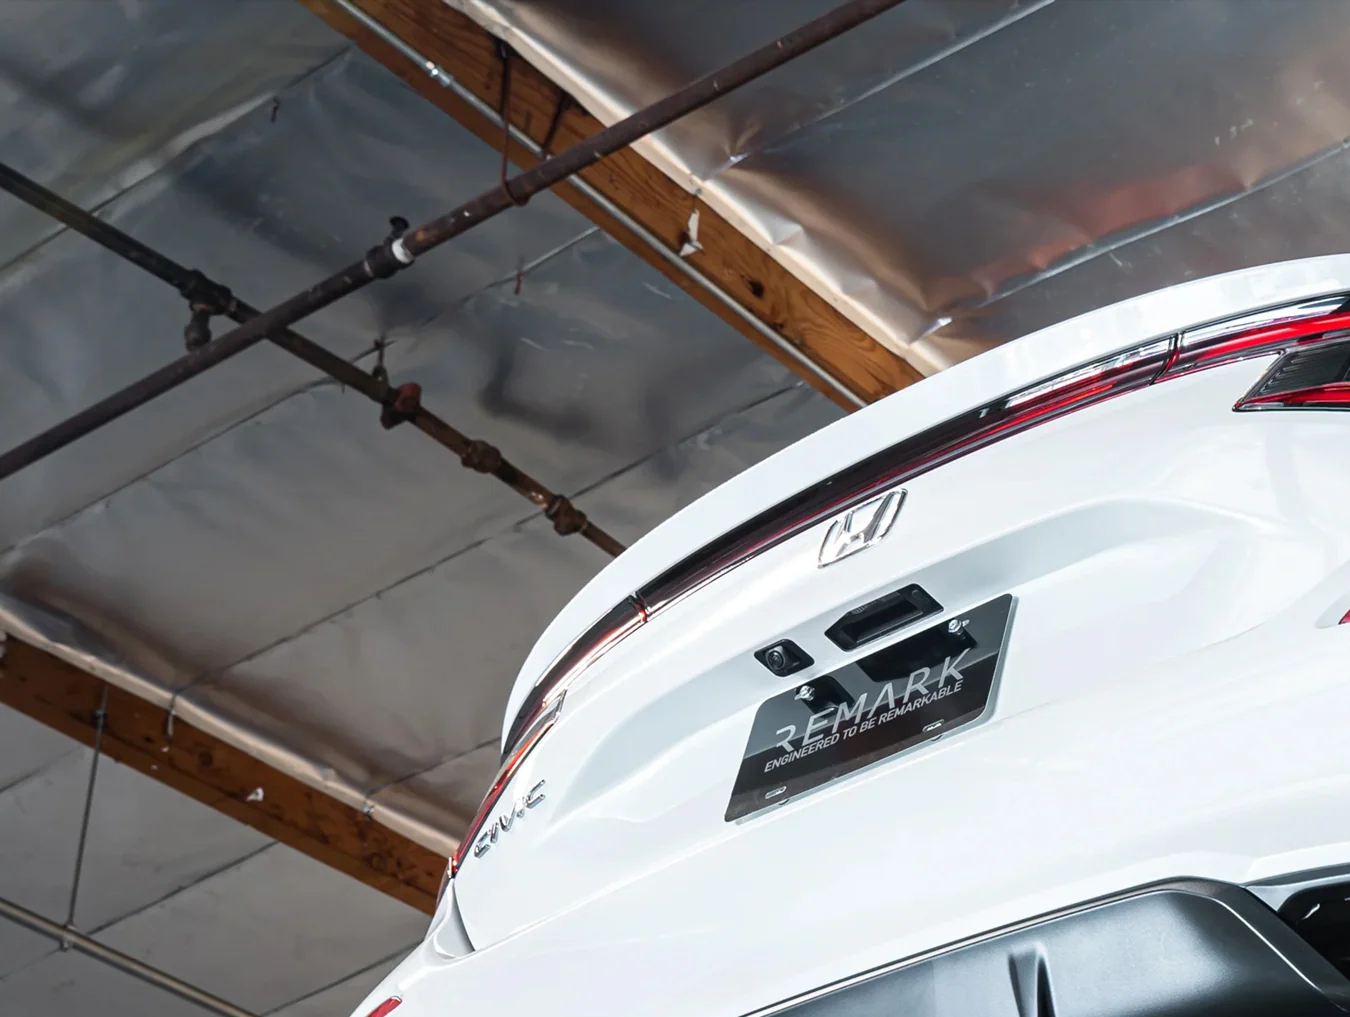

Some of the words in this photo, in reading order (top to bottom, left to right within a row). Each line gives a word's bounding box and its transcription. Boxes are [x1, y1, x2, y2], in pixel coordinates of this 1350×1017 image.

[764, 732, 840, 772] ENGINEERED
[843, 725, 858, 740] TO
[859, 717, 876, 733] BE
[878, 680, 964, 725] REMARKABLE
[774, 648, 972, 753] REMARK
